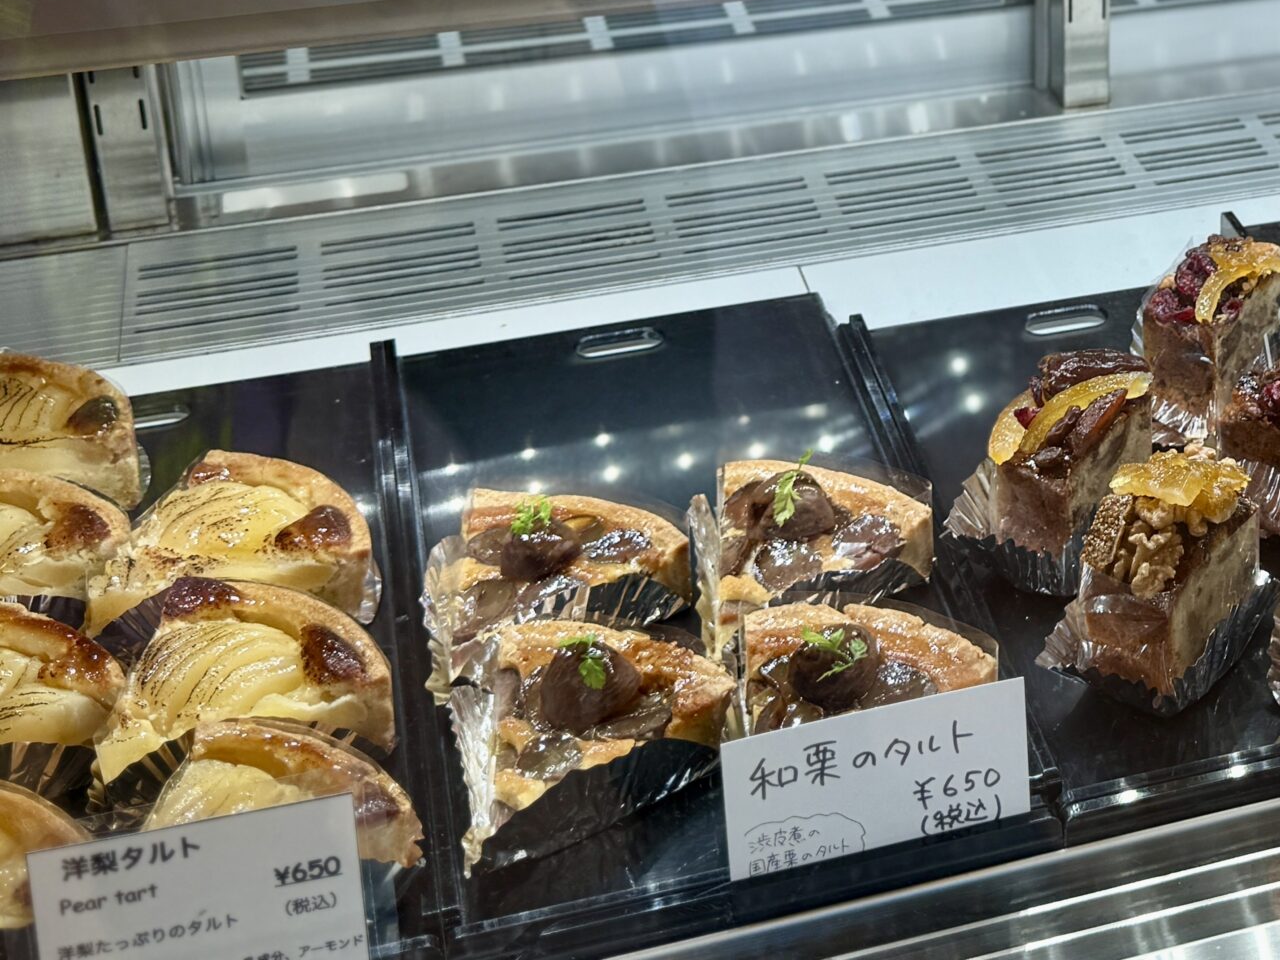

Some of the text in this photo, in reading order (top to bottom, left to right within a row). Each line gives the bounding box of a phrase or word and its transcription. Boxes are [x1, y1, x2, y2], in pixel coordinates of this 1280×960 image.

[750, 720, 973, 800] 和栗のタルト
[913, 768, 1000, 809] ¥650
[62, 837, 200, 882] 洋梨タルト
[274, 857, 342, 887] ¥650
[749, 838, 849, 875] 国産栗のタルト
[59, 885, 158, 916] Pear tart
[285, 892, 337, 917] （税込）
[58, 914, 238, 960] 洋梨たっぷりのタルト
